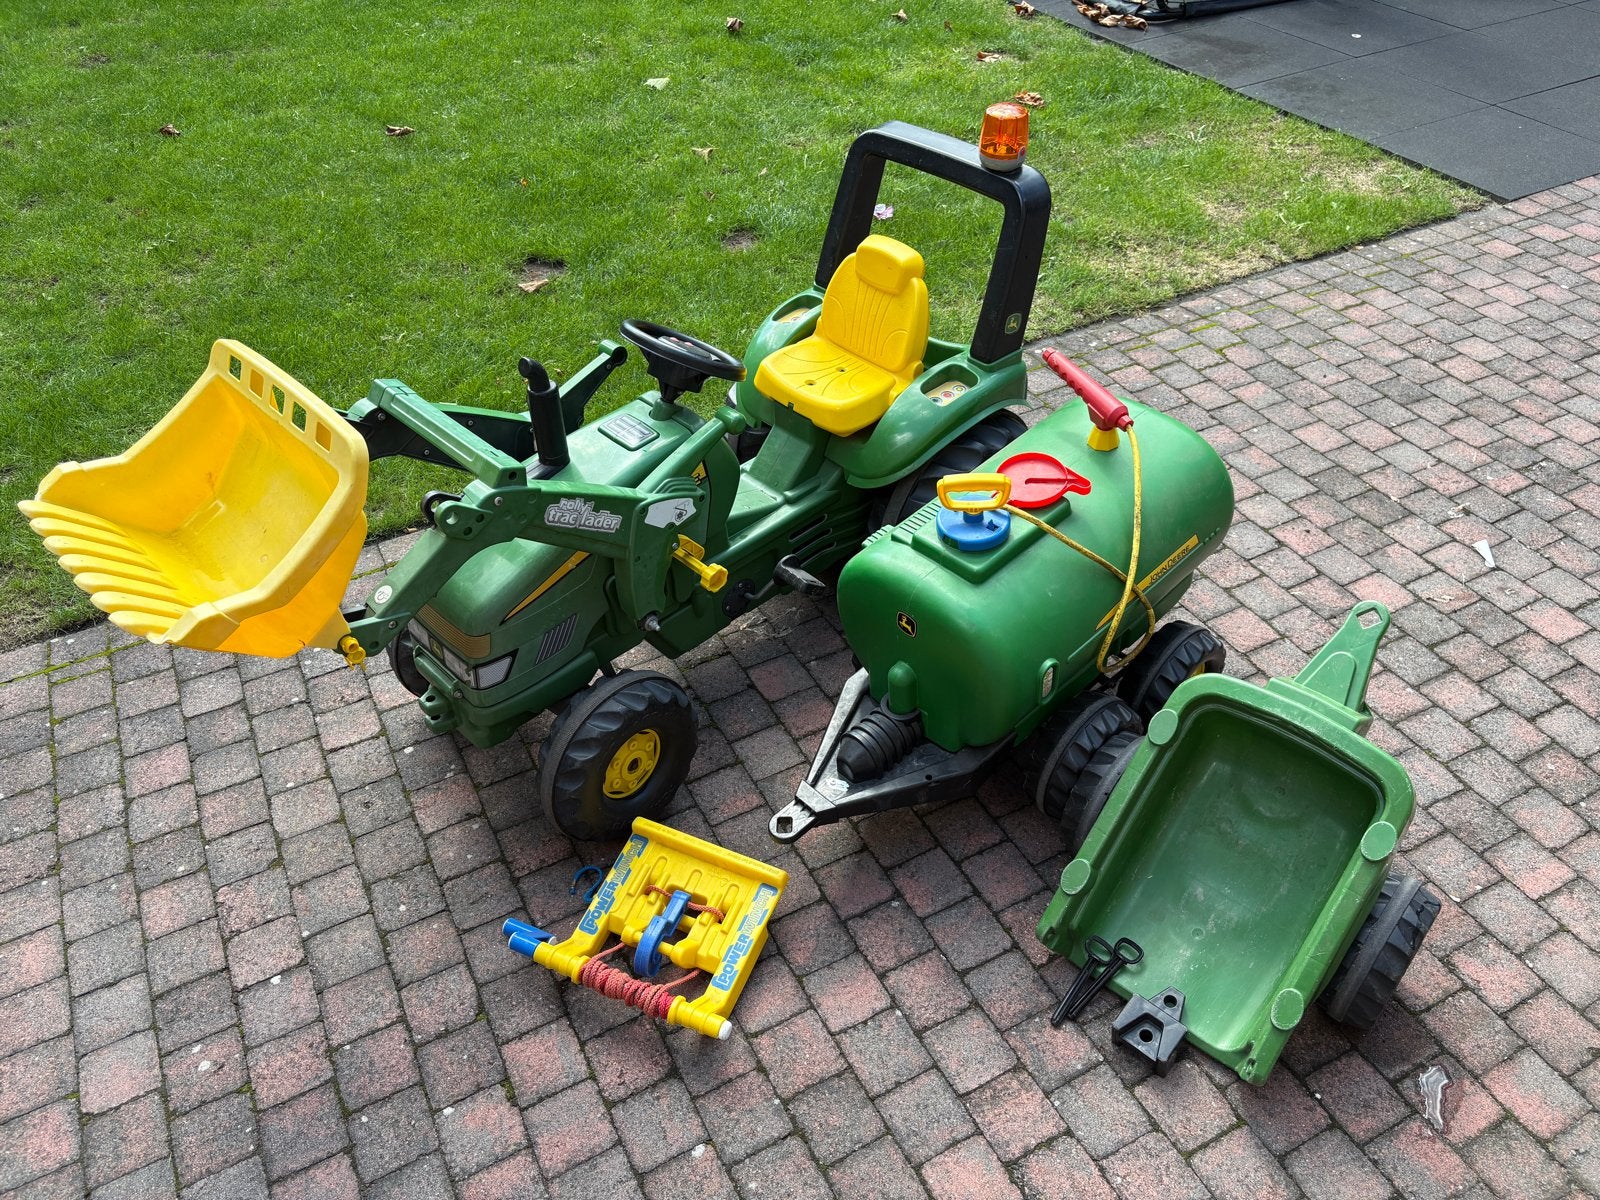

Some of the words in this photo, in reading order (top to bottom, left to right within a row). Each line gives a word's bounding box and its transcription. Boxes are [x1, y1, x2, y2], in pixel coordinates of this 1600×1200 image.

[560, 499, 589, 514] rolly
[1150, 565, 1168, 584] JOHN
[1168, 546, 1190, 567] DEERE
